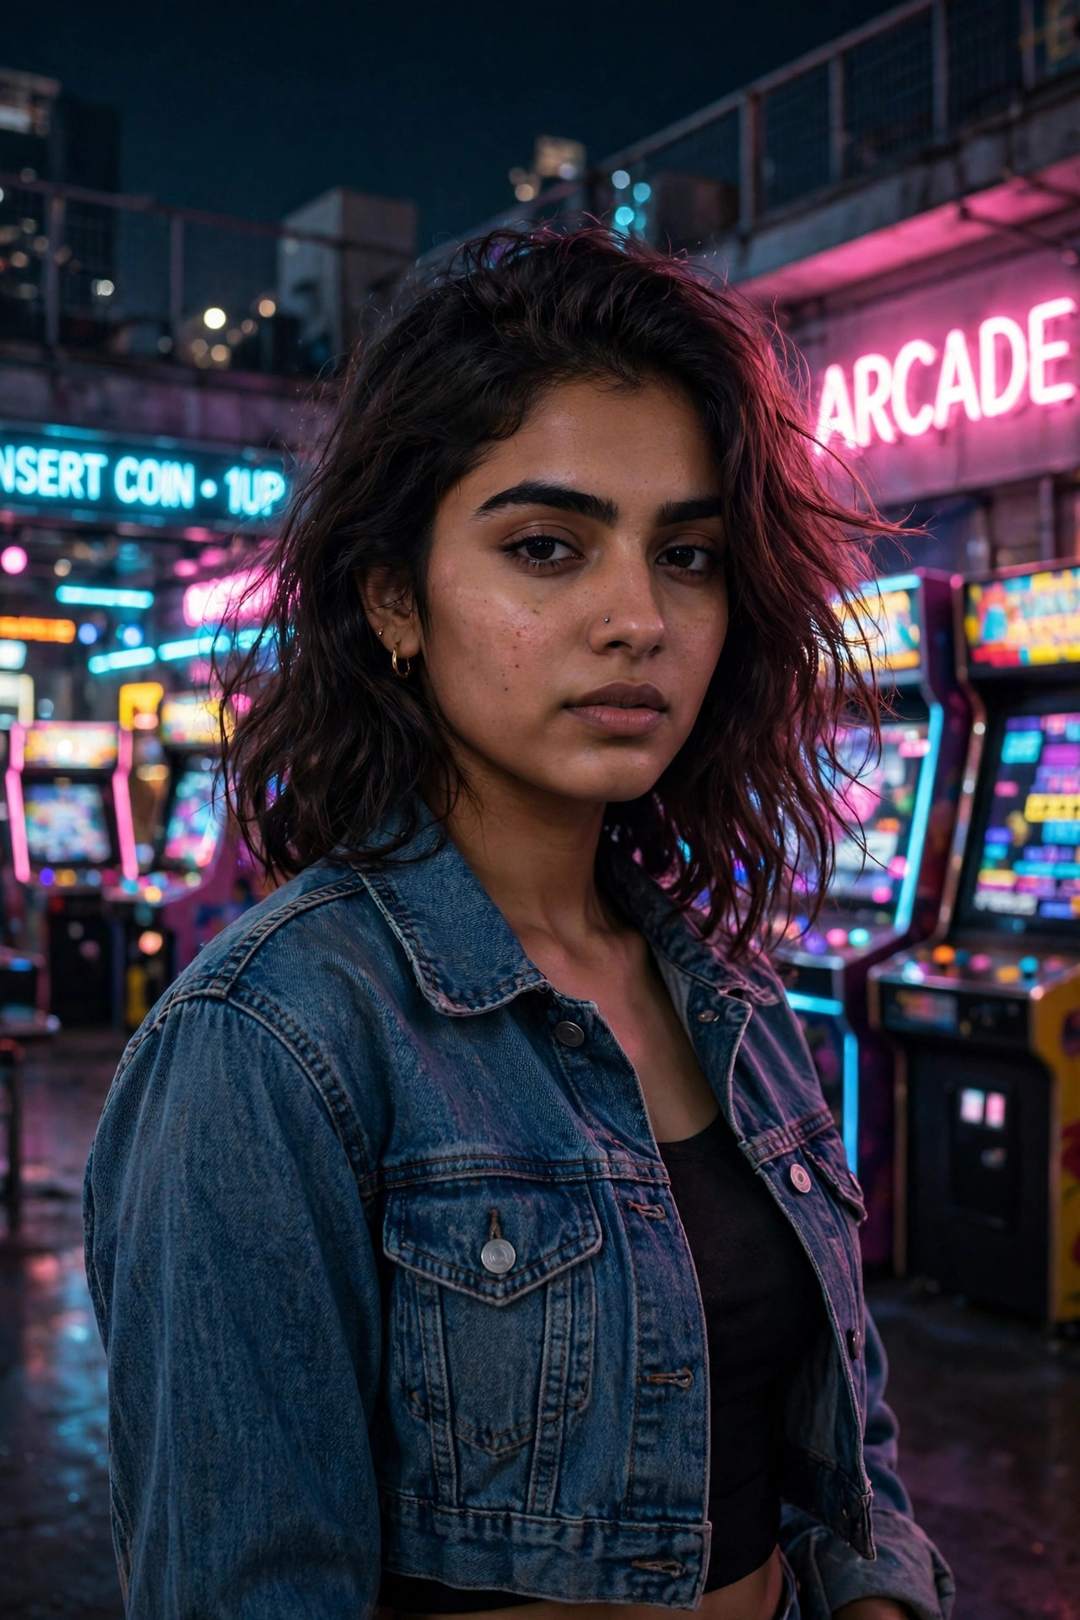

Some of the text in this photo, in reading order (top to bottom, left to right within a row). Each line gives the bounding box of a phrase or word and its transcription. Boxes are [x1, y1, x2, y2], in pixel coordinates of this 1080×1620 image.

[814, 297, 1076, 455] ARCADE
[114, 456, 195, 509] COIN
[224, 466, 285, 516] 1UP
